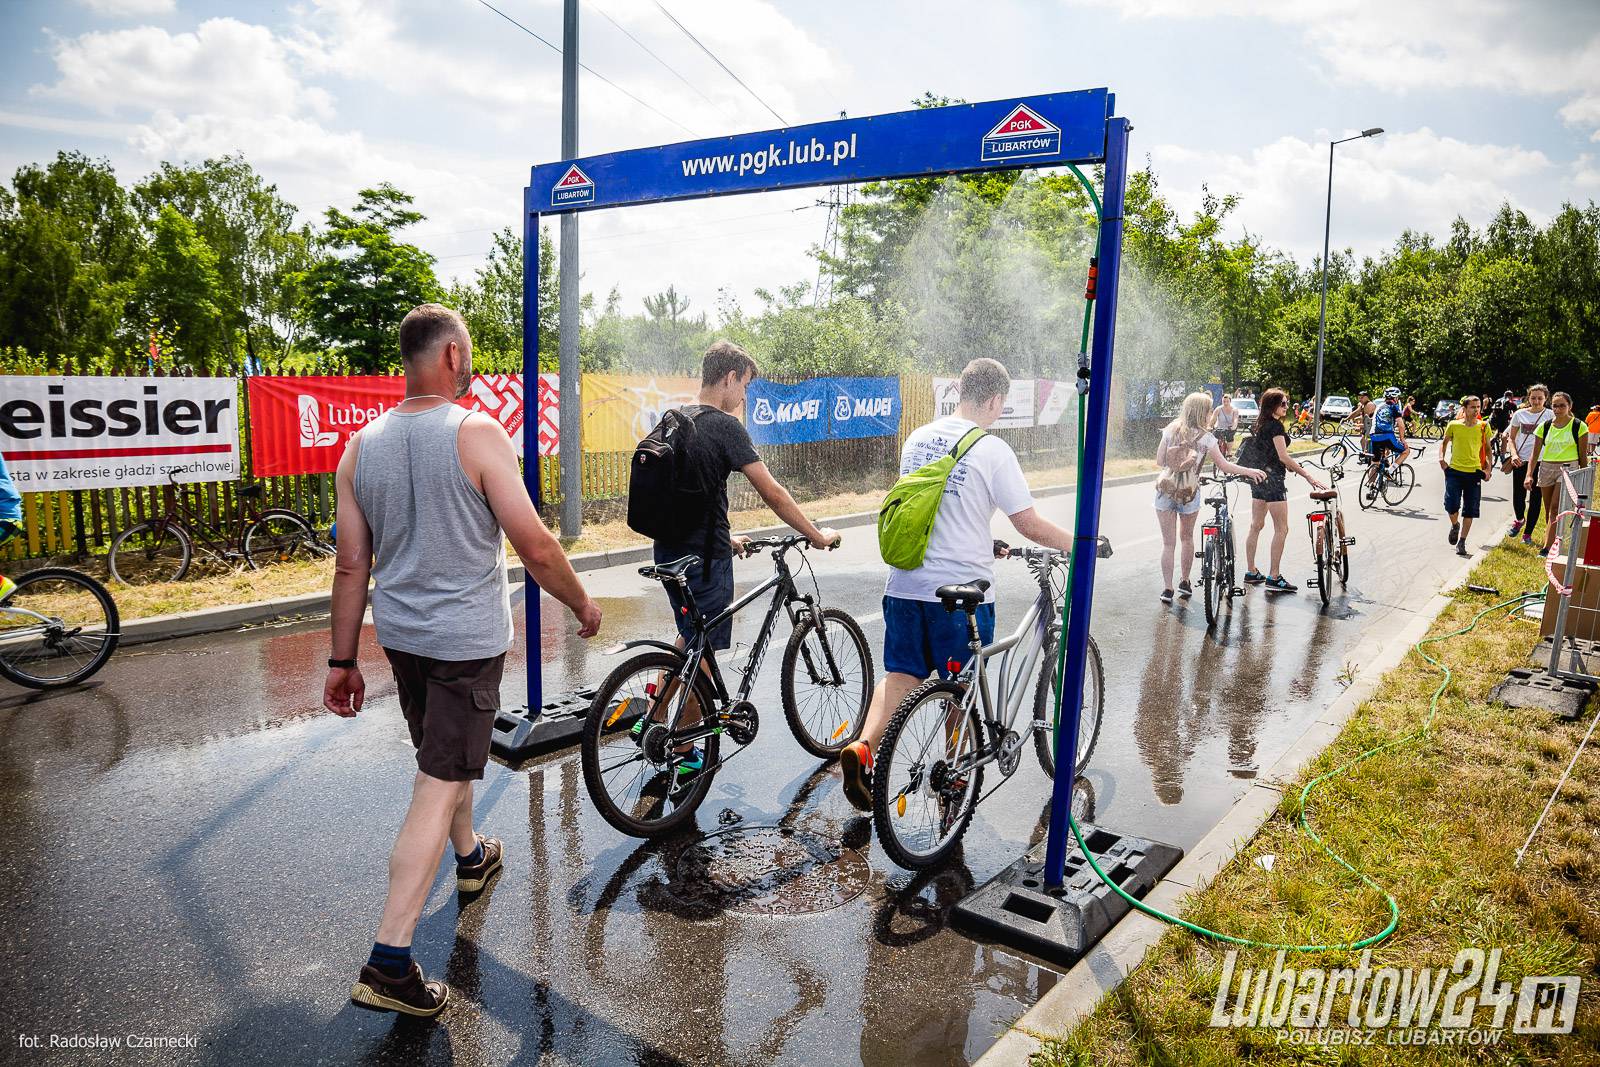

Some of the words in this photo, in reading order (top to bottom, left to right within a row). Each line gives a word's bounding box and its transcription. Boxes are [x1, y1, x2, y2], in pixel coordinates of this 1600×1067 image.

[1010, 119, 1032, 131] PGK
[991, 136, 1051, 153] LUBARTÓW
[681, 133, 857, 177] www.pgk.lub.pl
[567, 175, 580, 185] PGK
[557, 188, 590, 200] LUBARTÓW
[776, 399, 820, 423] MAPEI
[853, 397, 892, 418] MAPEI
[36, 471, 48, 480] w
[53, 465, 111, 480] zakresie
[115, 463, 155, 480] gładzi
[160, 459, 234, 476] szpachlowej
